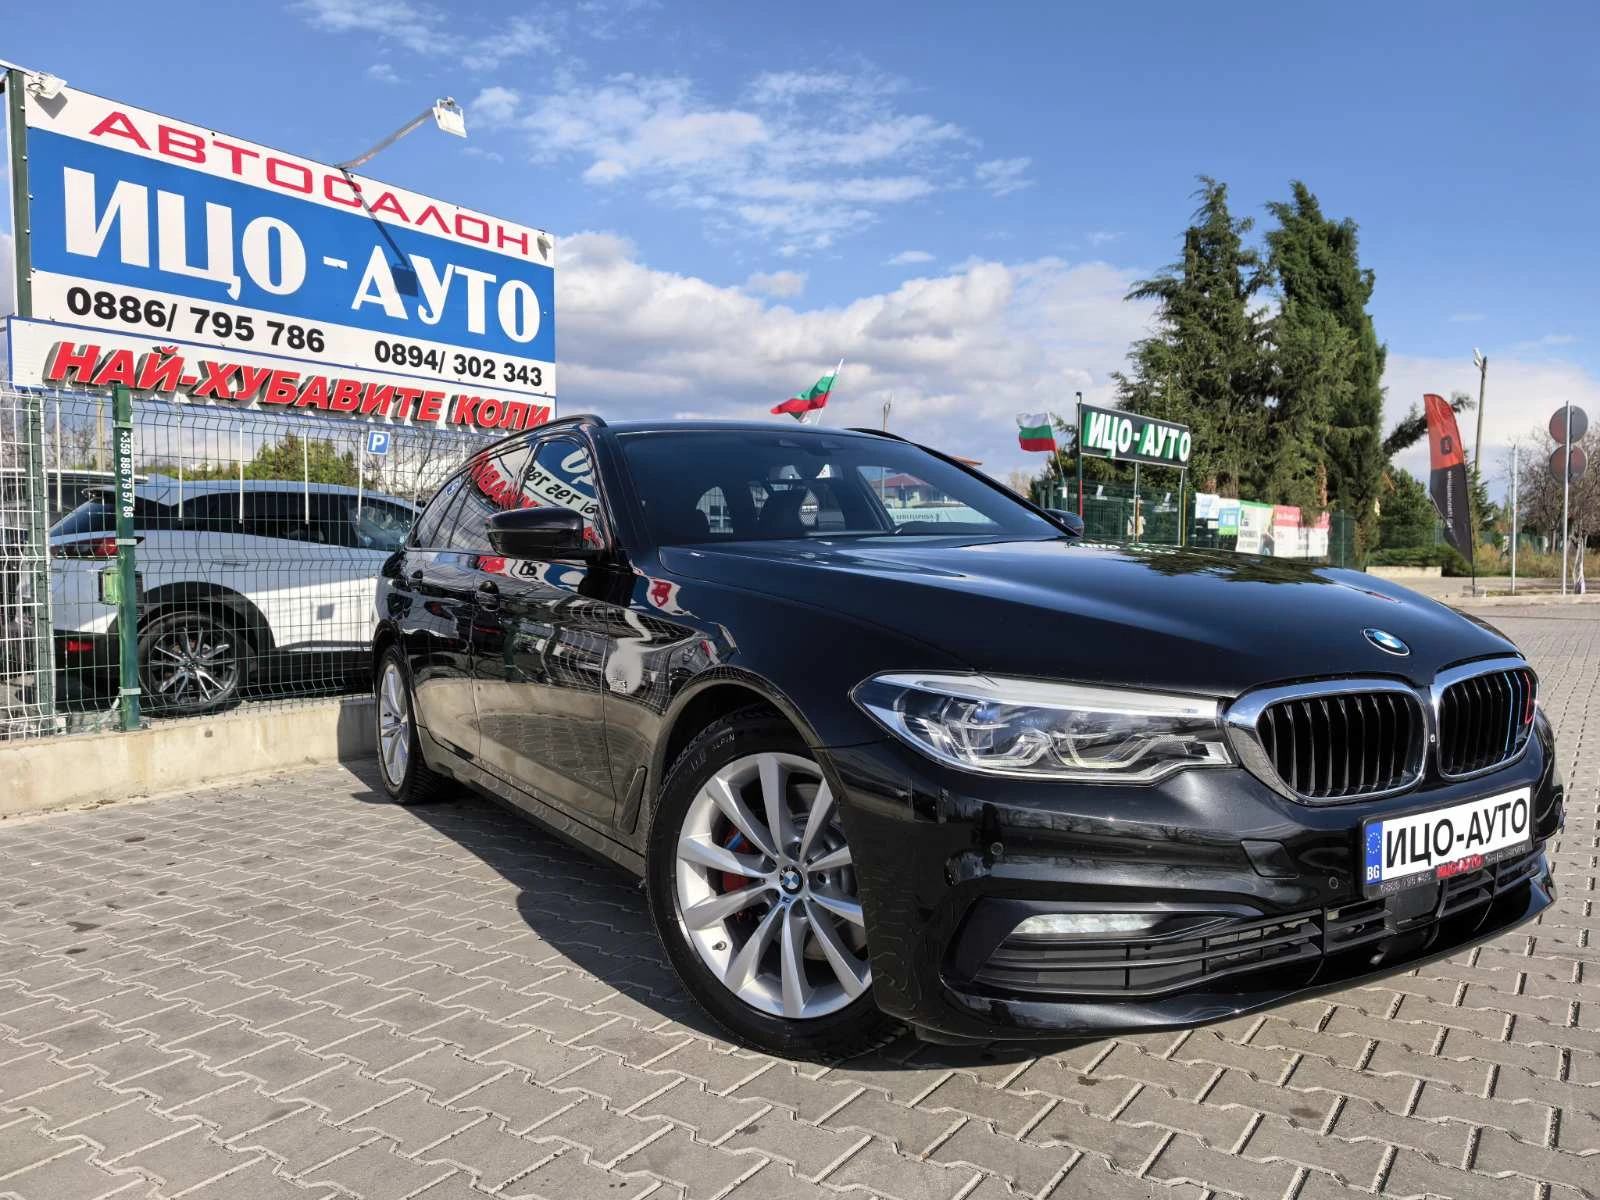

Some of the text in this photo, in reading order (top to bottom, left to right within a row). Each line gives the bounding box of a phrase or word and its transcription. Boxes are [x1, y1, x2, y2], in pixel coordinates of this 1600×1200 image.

[90, 110, 529, 256] АВТОСАЛОН
[67, 286, 325, 353] 0886/ 795 786
[47, 341, 550, 430] НАЙ-ХУБАВИТЕ КОЛИ
[374, 340, 543, 387] 0894/ 302 343
[373, 434, 386, 450] P
[1086, 411, 1192, 463] ИЦО-АУТО
[120, 431, 133, 518] +359 886 79 57 86
[1386, 797, 1528, 868] ИЦО-АУТО
[1366, 865, 1380, 881] BG
